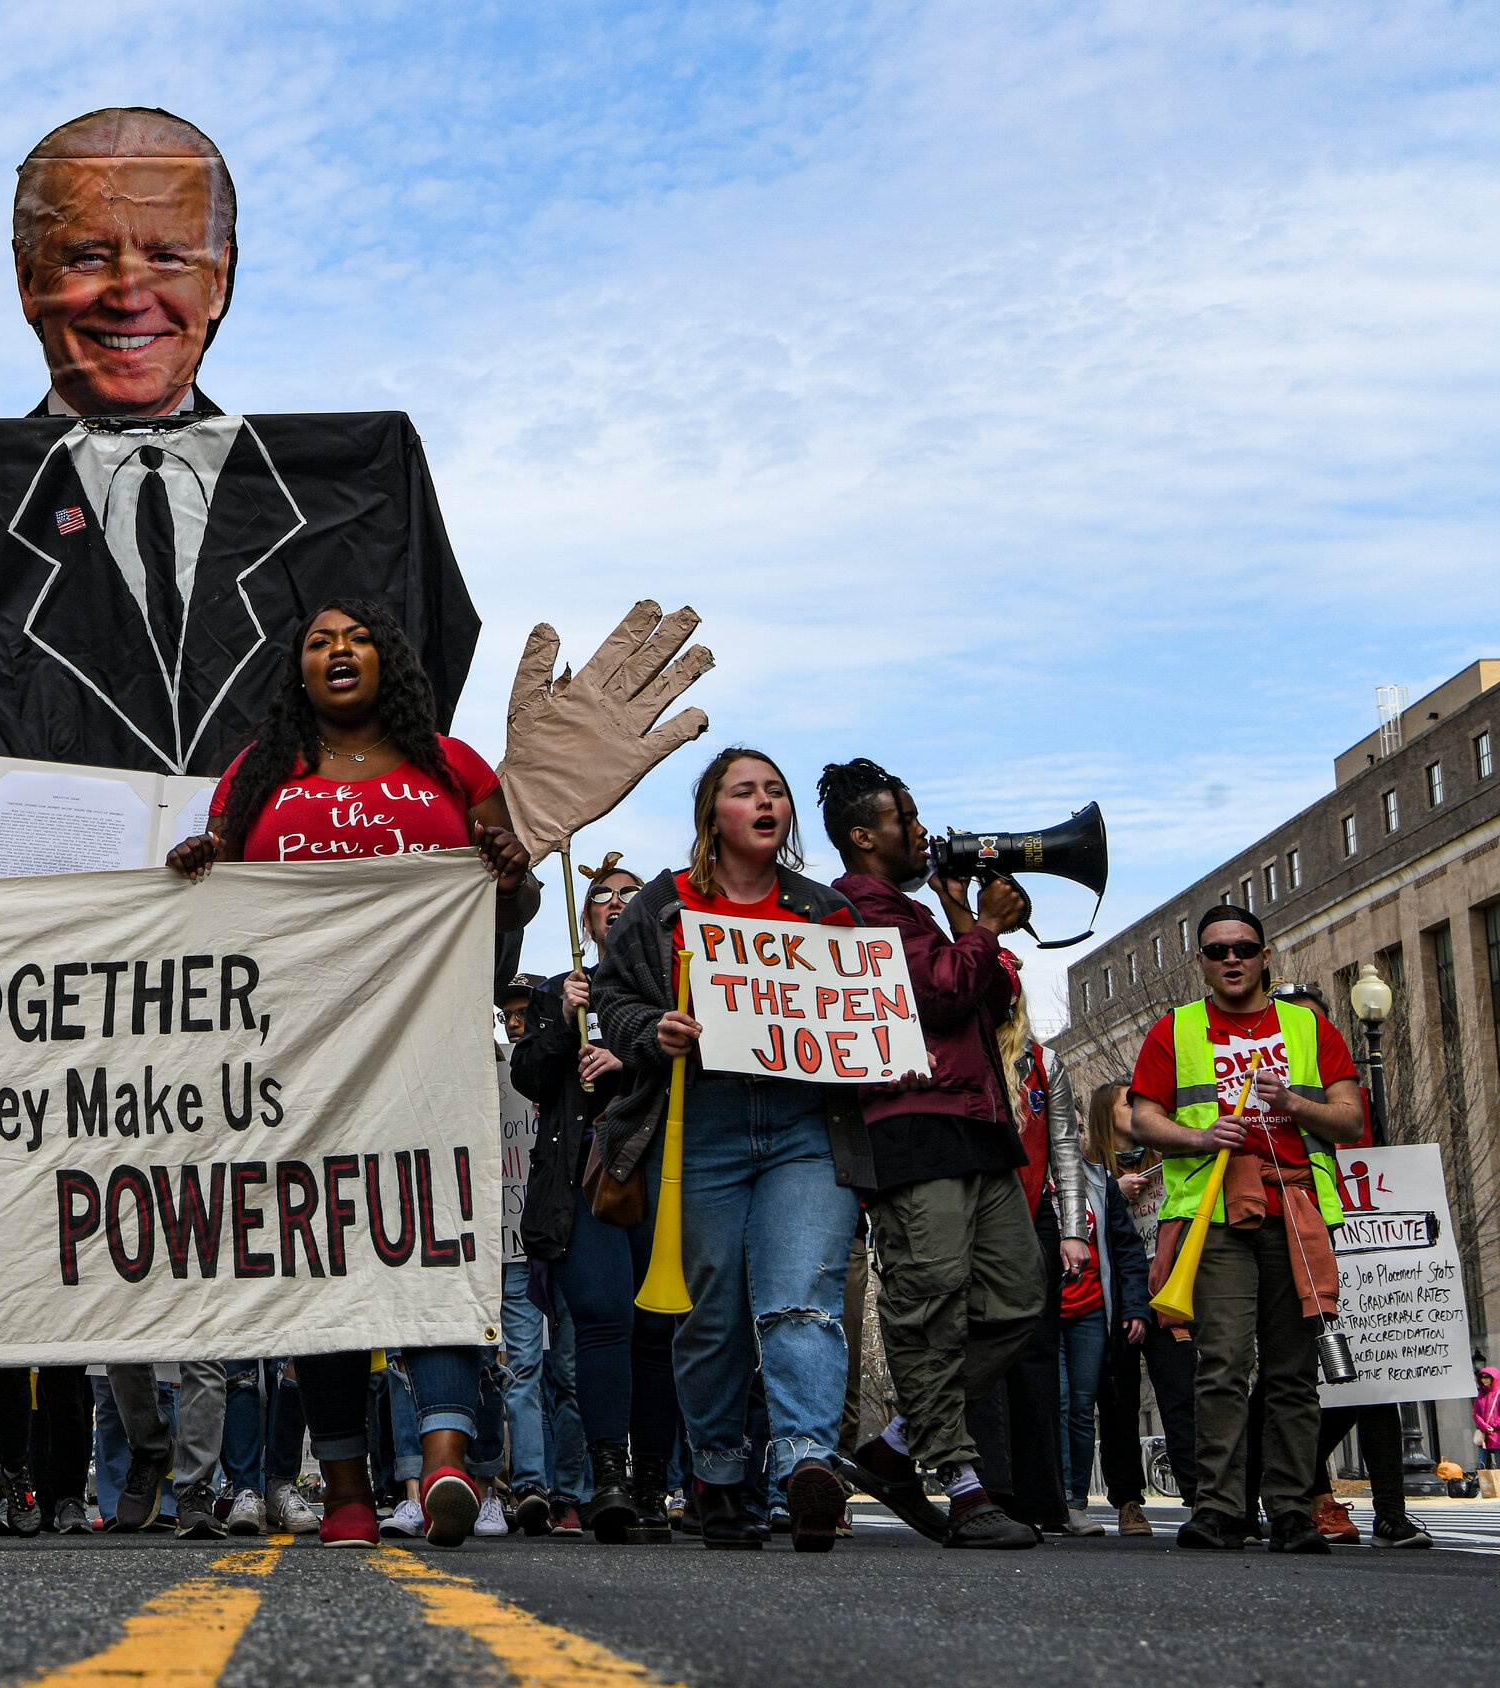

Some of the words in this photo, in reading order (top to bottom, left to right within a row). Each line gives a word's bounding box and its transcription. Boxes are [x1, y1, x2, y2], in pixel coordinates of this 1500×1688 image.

[275, 785, 362, 810] Pick
[380, 782, 439, 807] Up
[329, 801, 394, 828] the
[278, 833, 364, 862] Pen,
[699, 923, 817, 972] PICK
[829, 938, 893, 978] UP
[710, 973, 806, 1019] THE
[816, 982, 918, 1024] PEN,
[751, 1024, 893, 1078] JOE!
[66, 1064, 204, 1139] Make
[221, 1062, 284, 1132] Us
[500, 1109, 539, 1139] orld
[56, 1146, 476, 1286] POWERFUL!
[1340, 1219, 1426, 1245] INSTITUTE
[1376, 1260, 1423, 1287] Placement
[1427, 1259, 1456, 1284] Stats
[1359, 1290, 1413, 1313] GRADUATION
[1417, 1286, 1451, 1304] RATES
[1427, 1308, 1464, 1323] CREDITS
